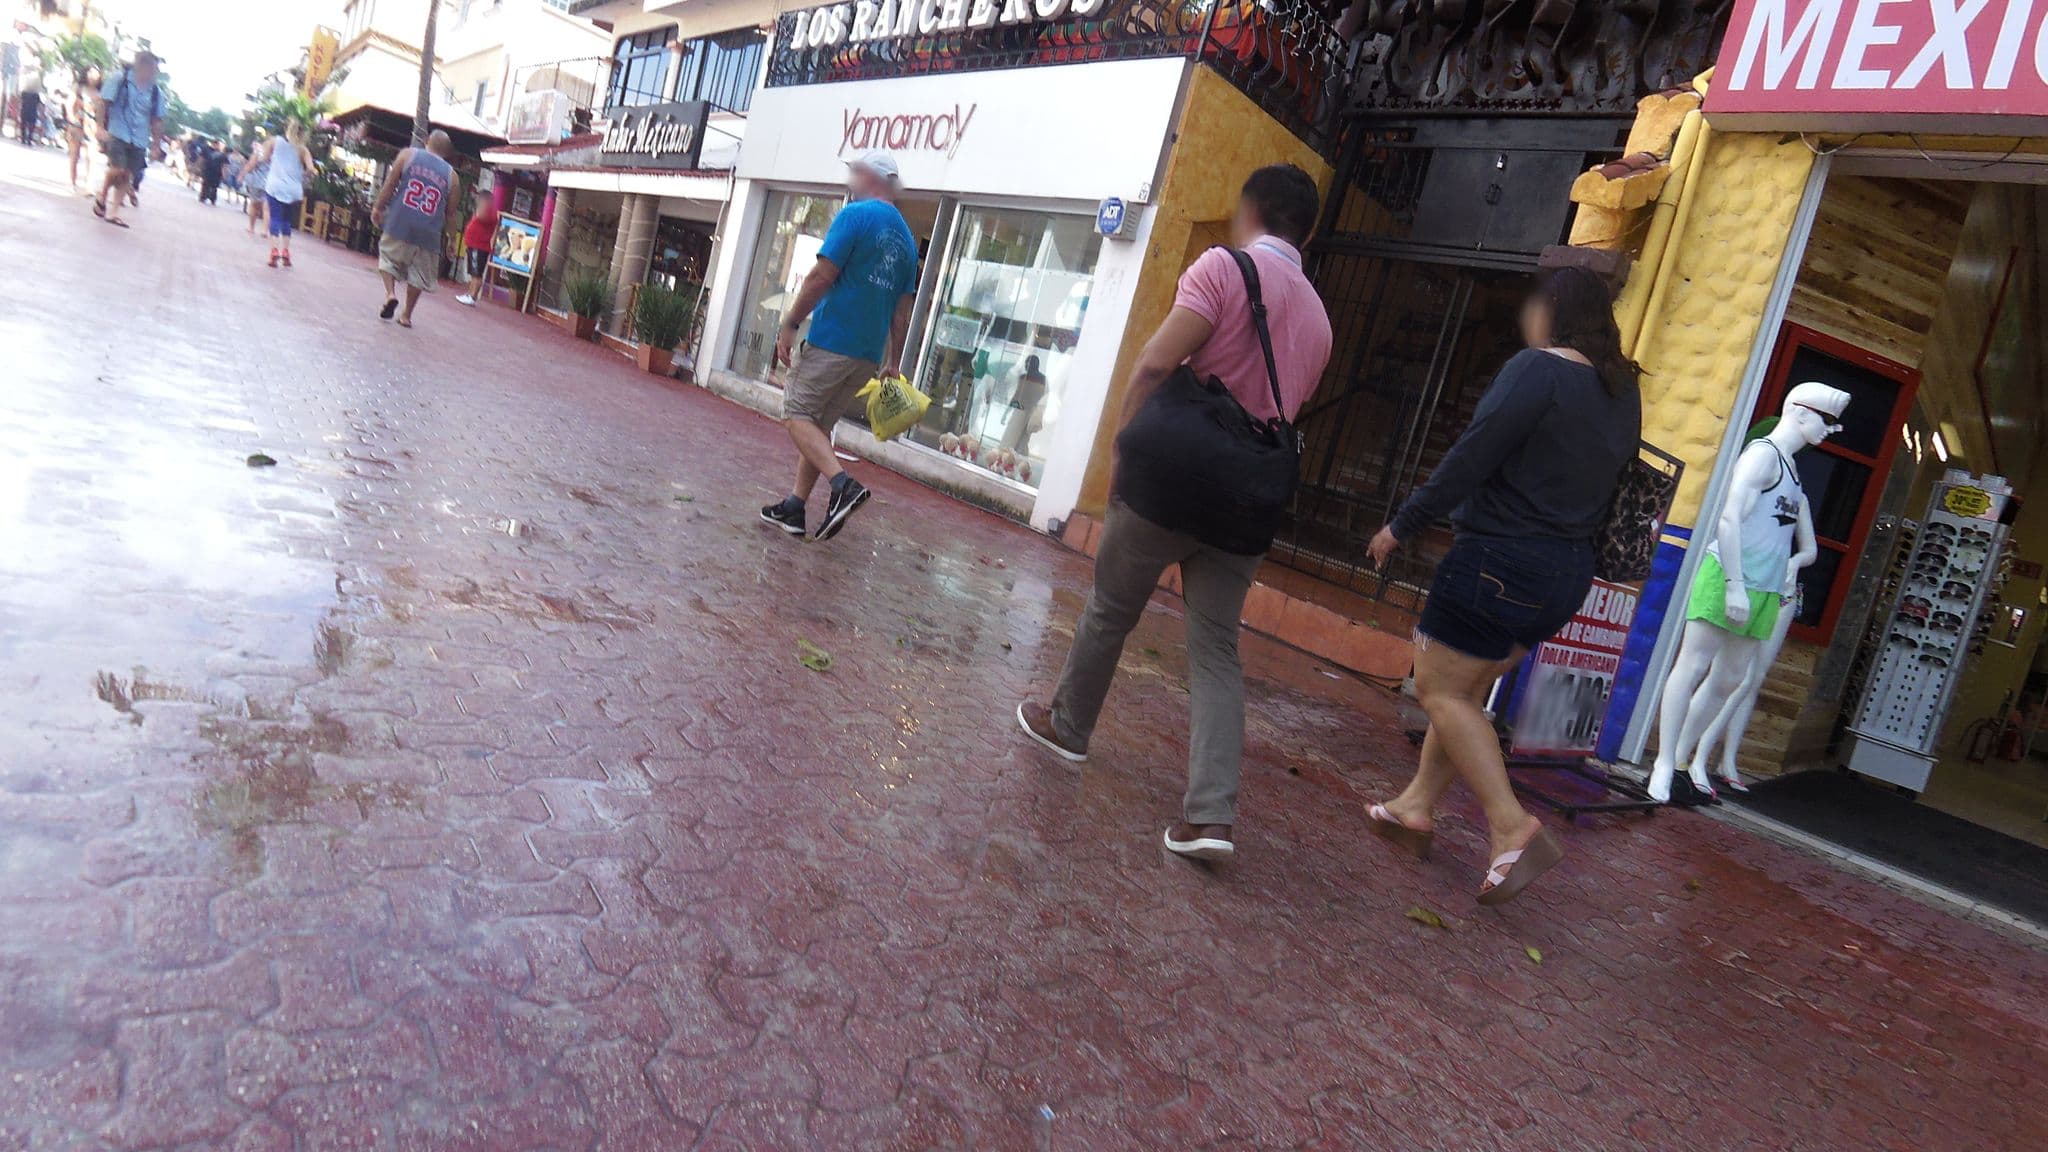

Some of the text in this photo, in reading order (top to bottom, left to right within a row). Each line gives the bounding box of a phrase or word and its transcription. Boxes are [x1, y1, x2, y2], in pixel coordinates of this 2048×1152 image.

[790, 0, 1102, 49] LOS RANCHE
[1727, 0, 2048, 91] MEXI
[632, 109, 694, 159] Mexicano
[403, 178, 442, 216] 23
[1102, 205, 1121, 220] ADT
[1576, 584, 1637, 627] MEJOR
[1540, 646, 1618, 674] DOLAR AMERICANO
